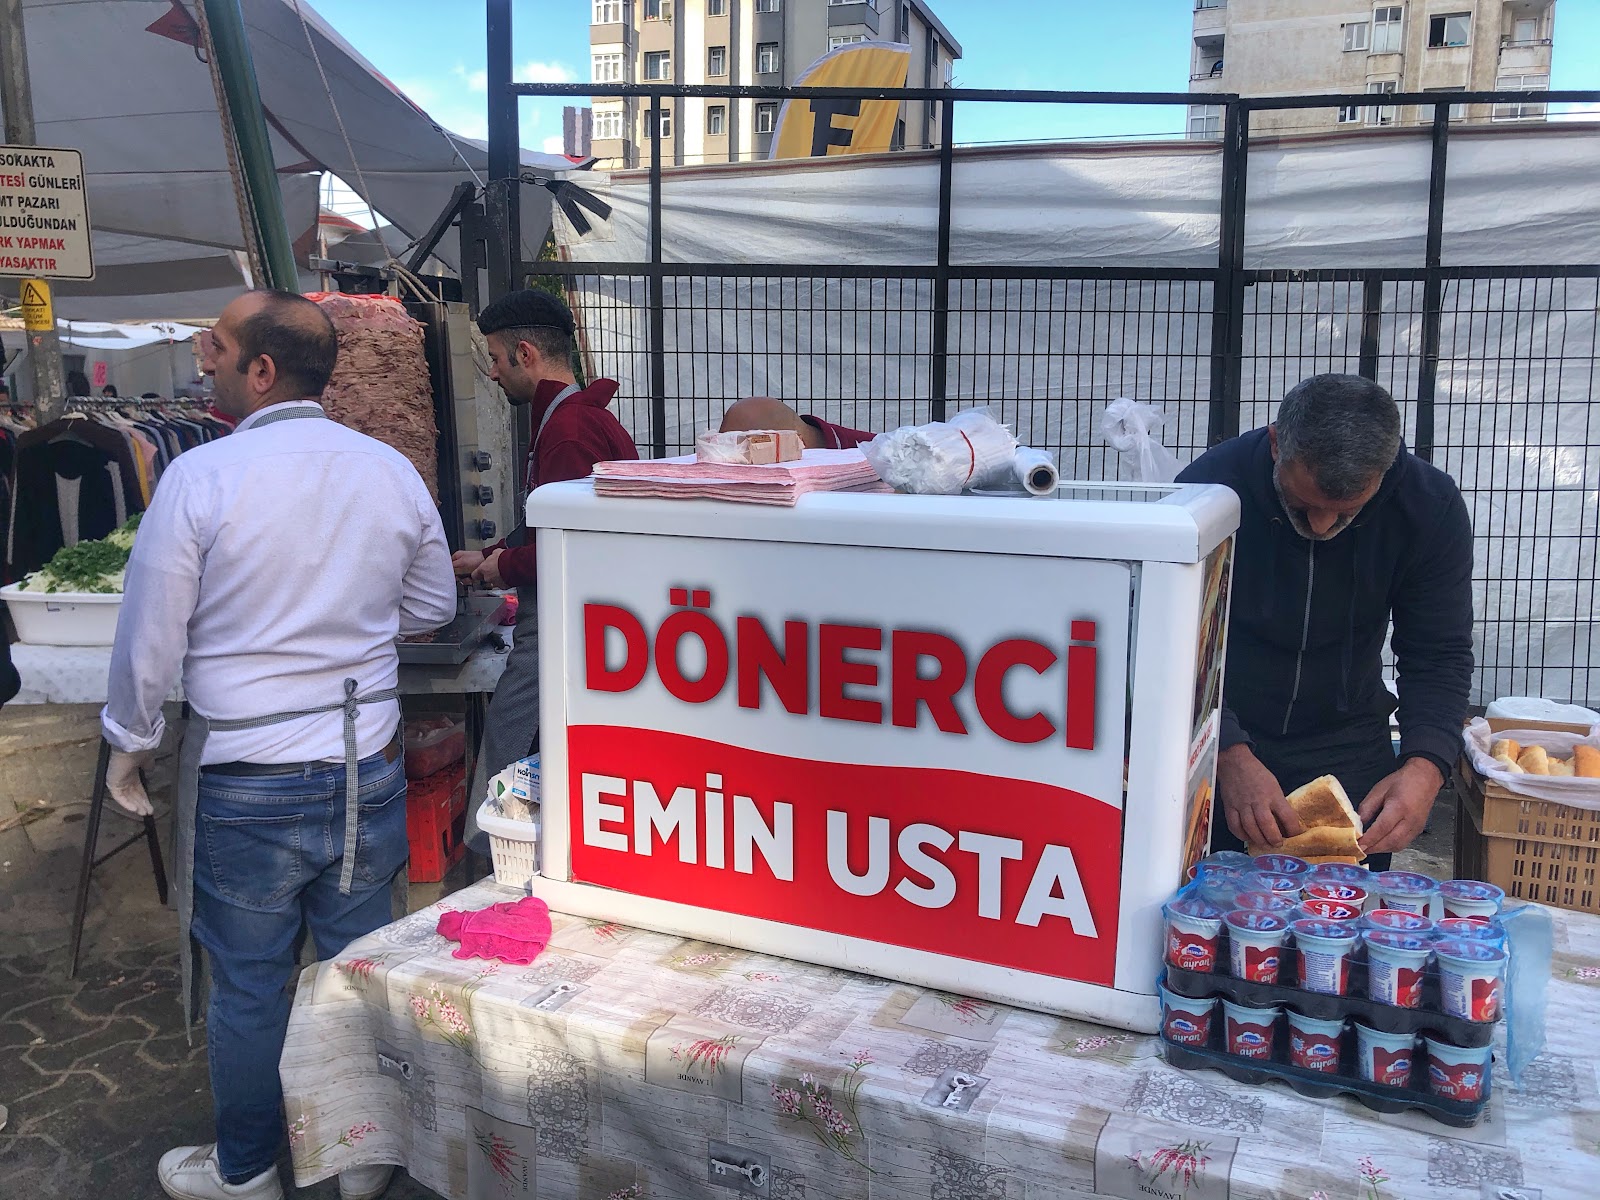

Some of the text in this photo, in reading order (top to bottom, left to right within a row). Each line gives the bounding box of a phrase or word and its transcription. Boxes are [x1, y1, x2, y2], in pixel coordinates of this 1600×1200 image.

[0, 154, 55, 168] SOKAKTA
[29, 174, 81, 190] GÜNLERİ
[18, 196, 60, 210] PAZARI
[0, 214, 77, 231] LDUĞUNDAN
[16, 236, 65, 251] YAPMAK
[584, 588, 1096, 750] DÖNERCİ
[581, 772, 1099, 939] EMİN USTA
[1183, 958, 1210, 970] ayran
[1172, 1033, 1200, 1043] ayran
[1240, 1046, 1267, 1057] ayran
[1310, 1057, 1337, 1072] ayran
[677, 1073, 709, 1086] LAVANDE
